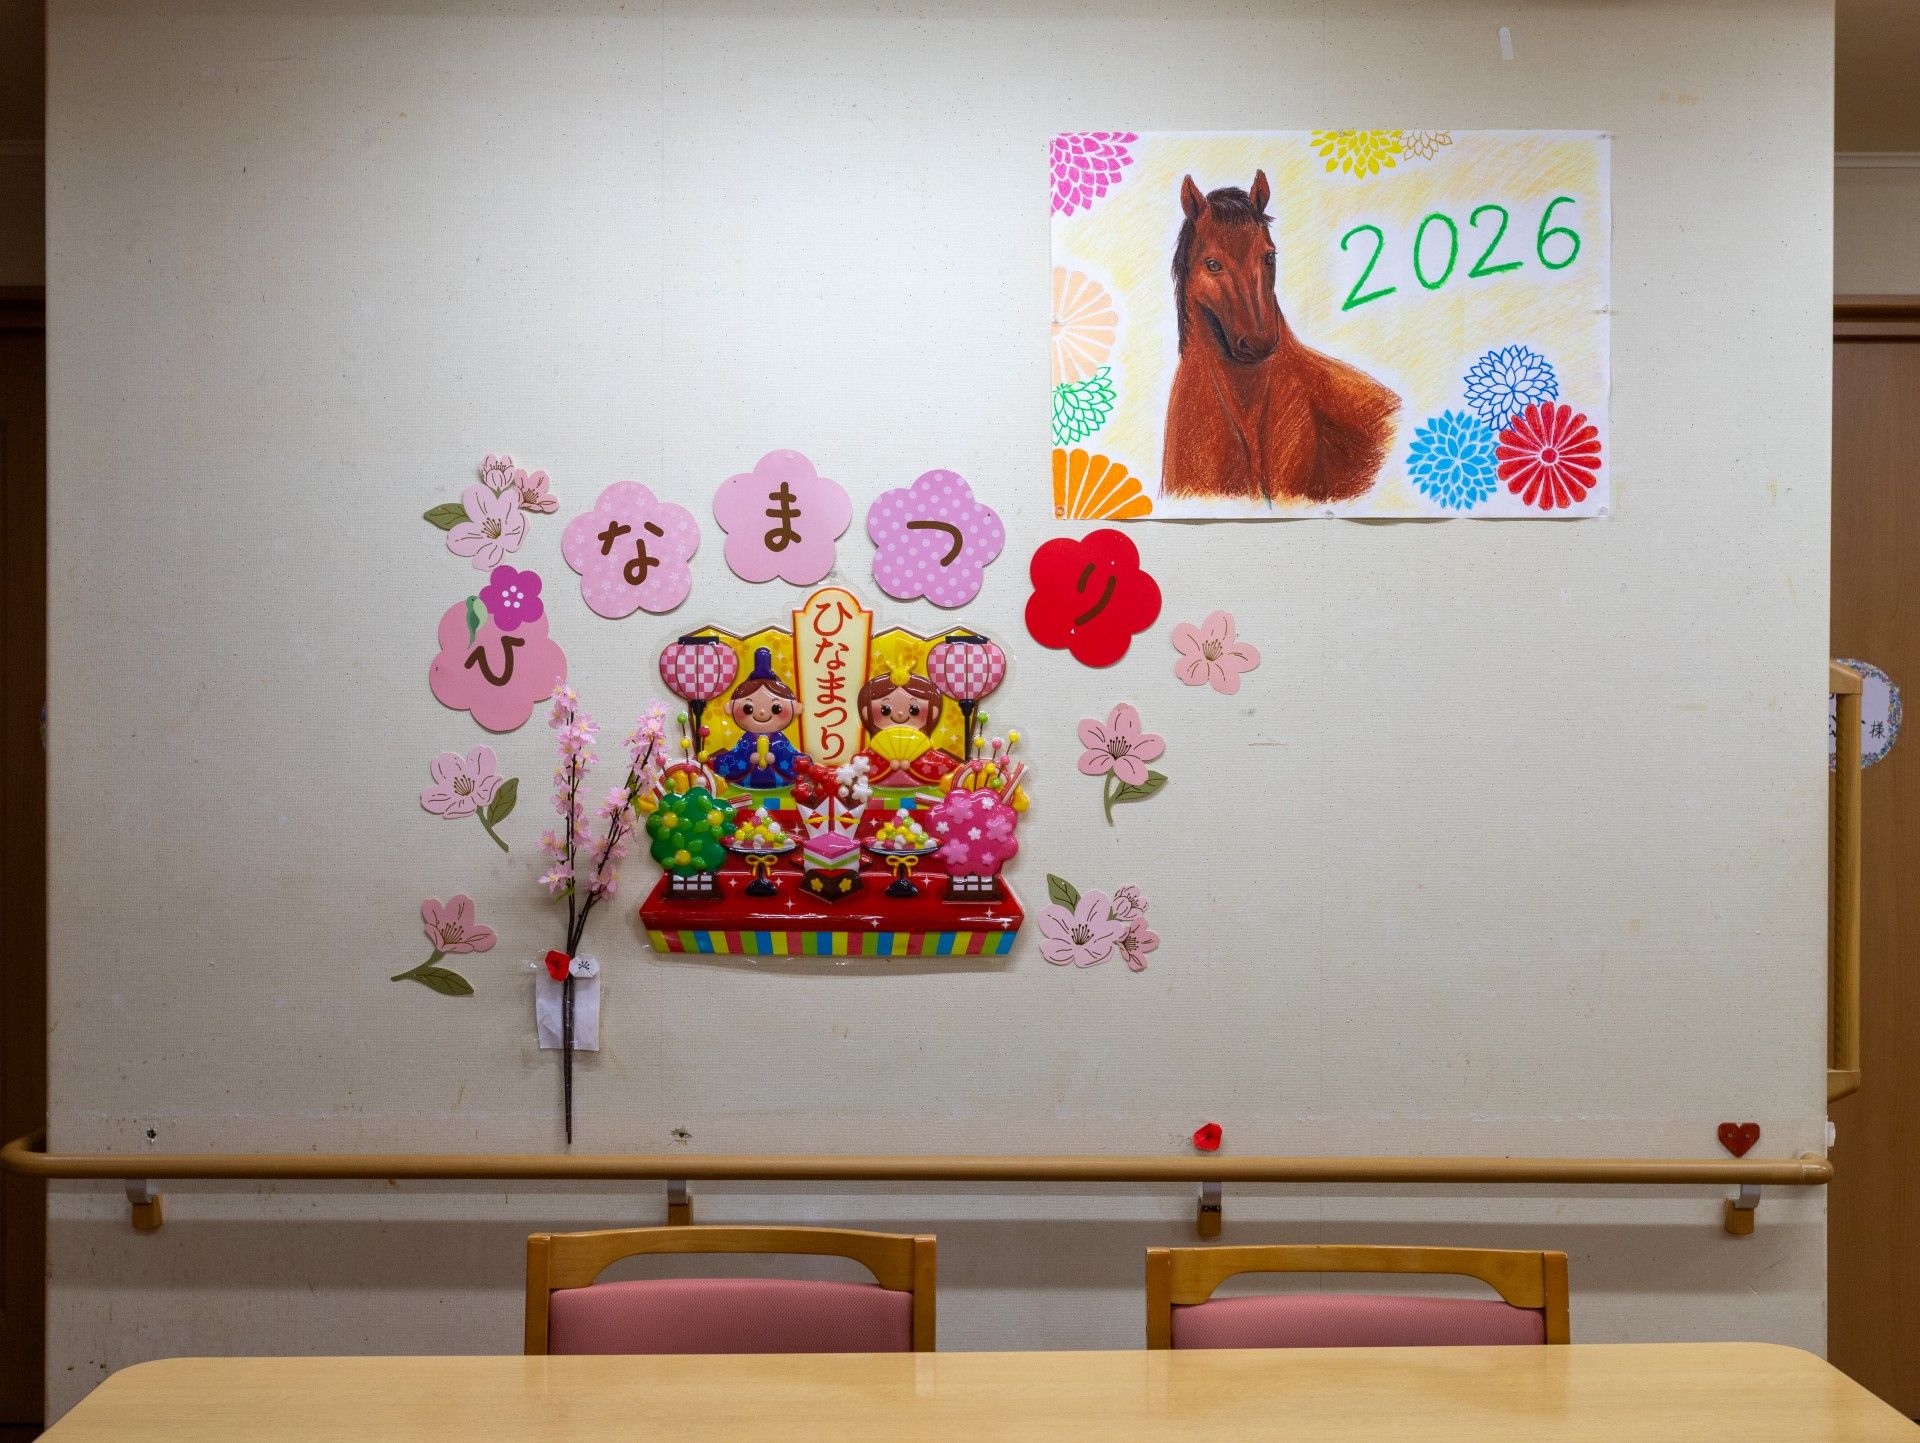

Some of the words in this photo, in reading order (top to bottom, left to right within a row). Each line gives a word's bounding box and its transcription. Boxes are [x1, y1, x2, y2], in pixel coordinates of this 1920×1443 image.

[1341, 196, 1581, 311] 2026
[812, 600, 854, 760] ひなまつり
